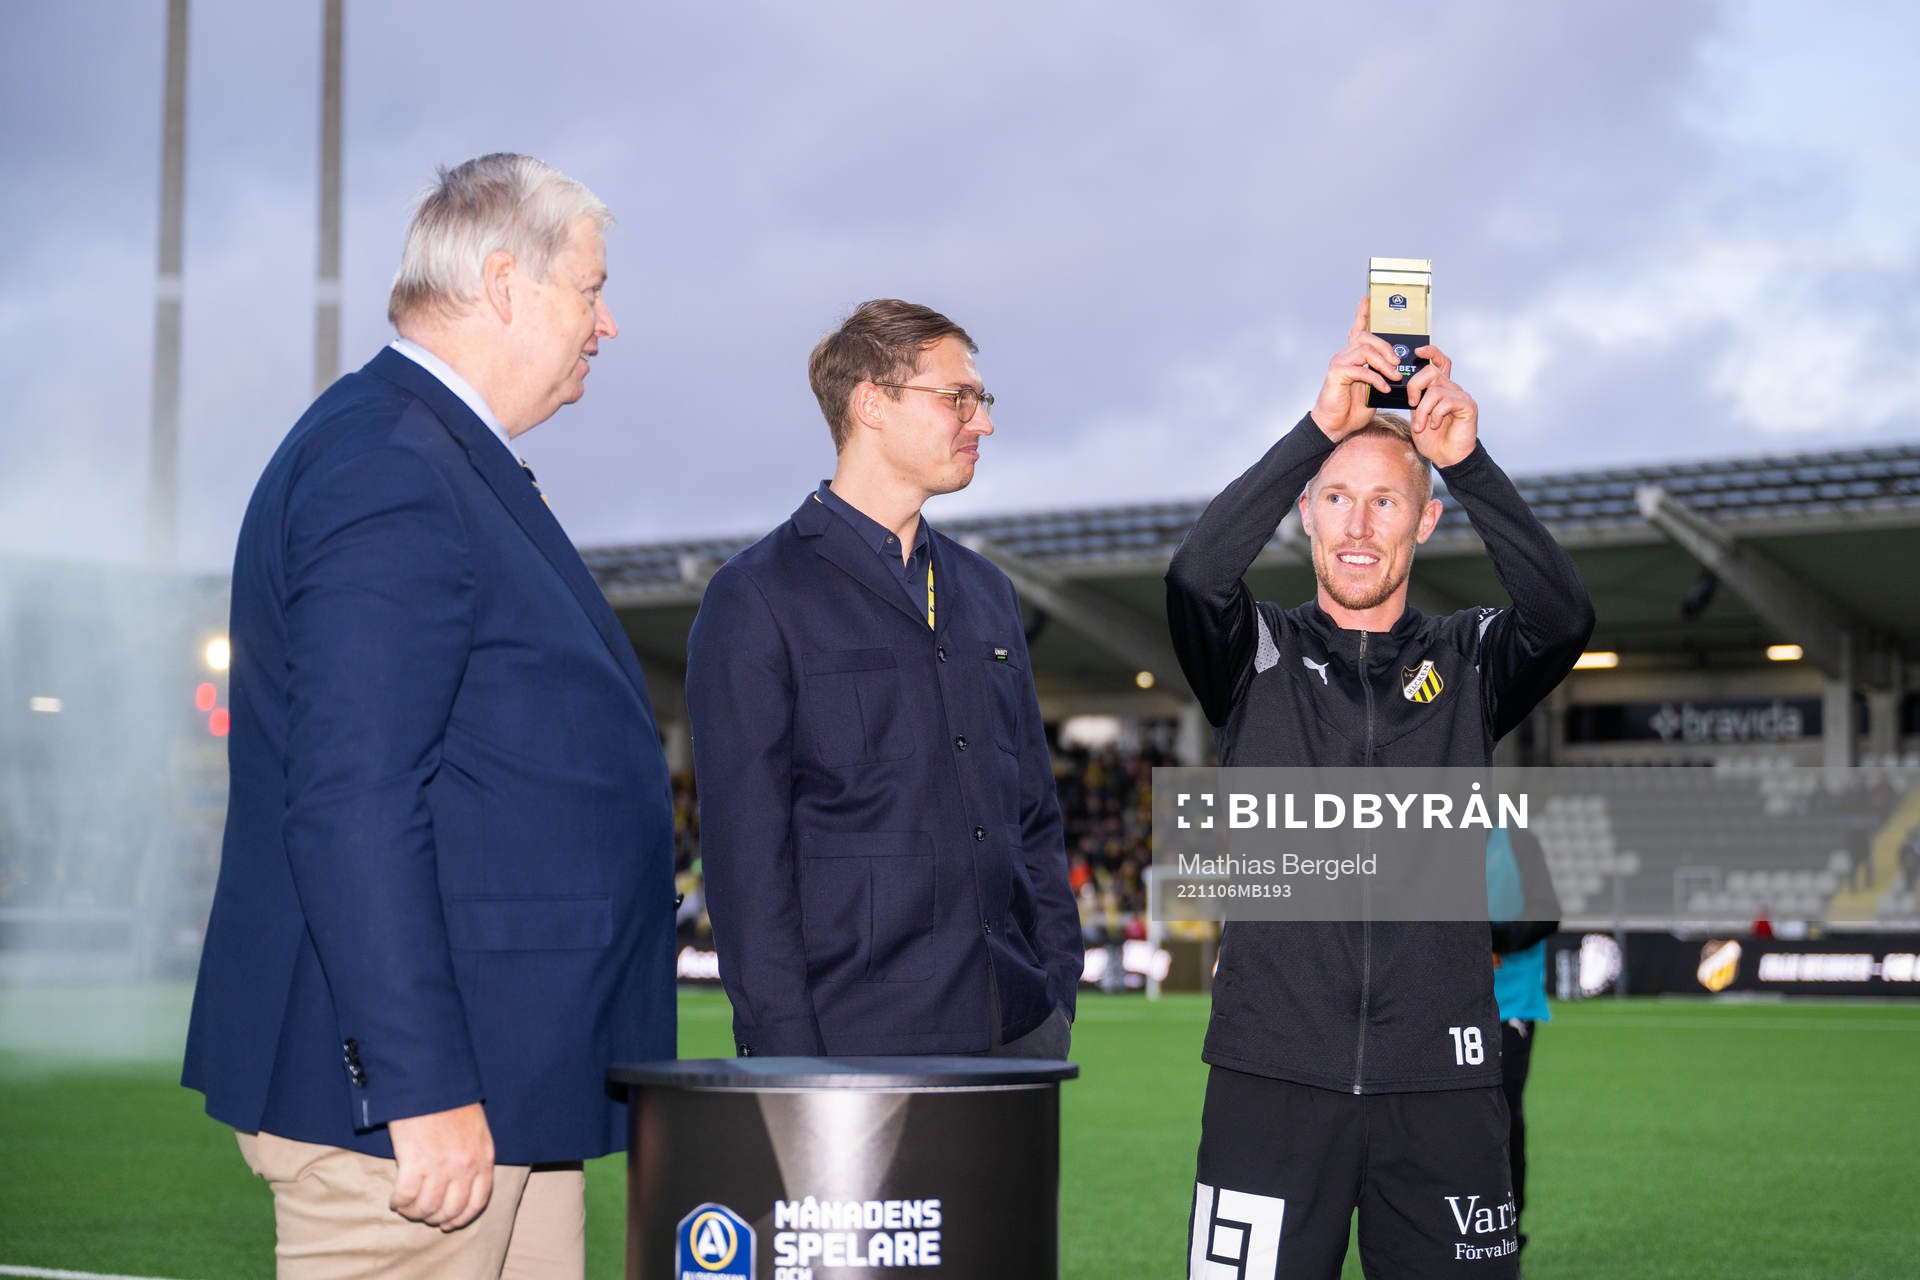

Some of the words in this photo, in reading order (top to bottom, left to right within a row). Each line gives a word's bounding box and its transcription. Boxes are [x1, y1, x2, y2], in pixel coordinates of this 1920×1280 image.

[1682, 700, 1803, 736] bravida
[1448, 1026, 1484, 1065] 18
[774, 1196, 941, 1230] MÅNADENS
[774, 1231, 941, 1267] SPELARE
